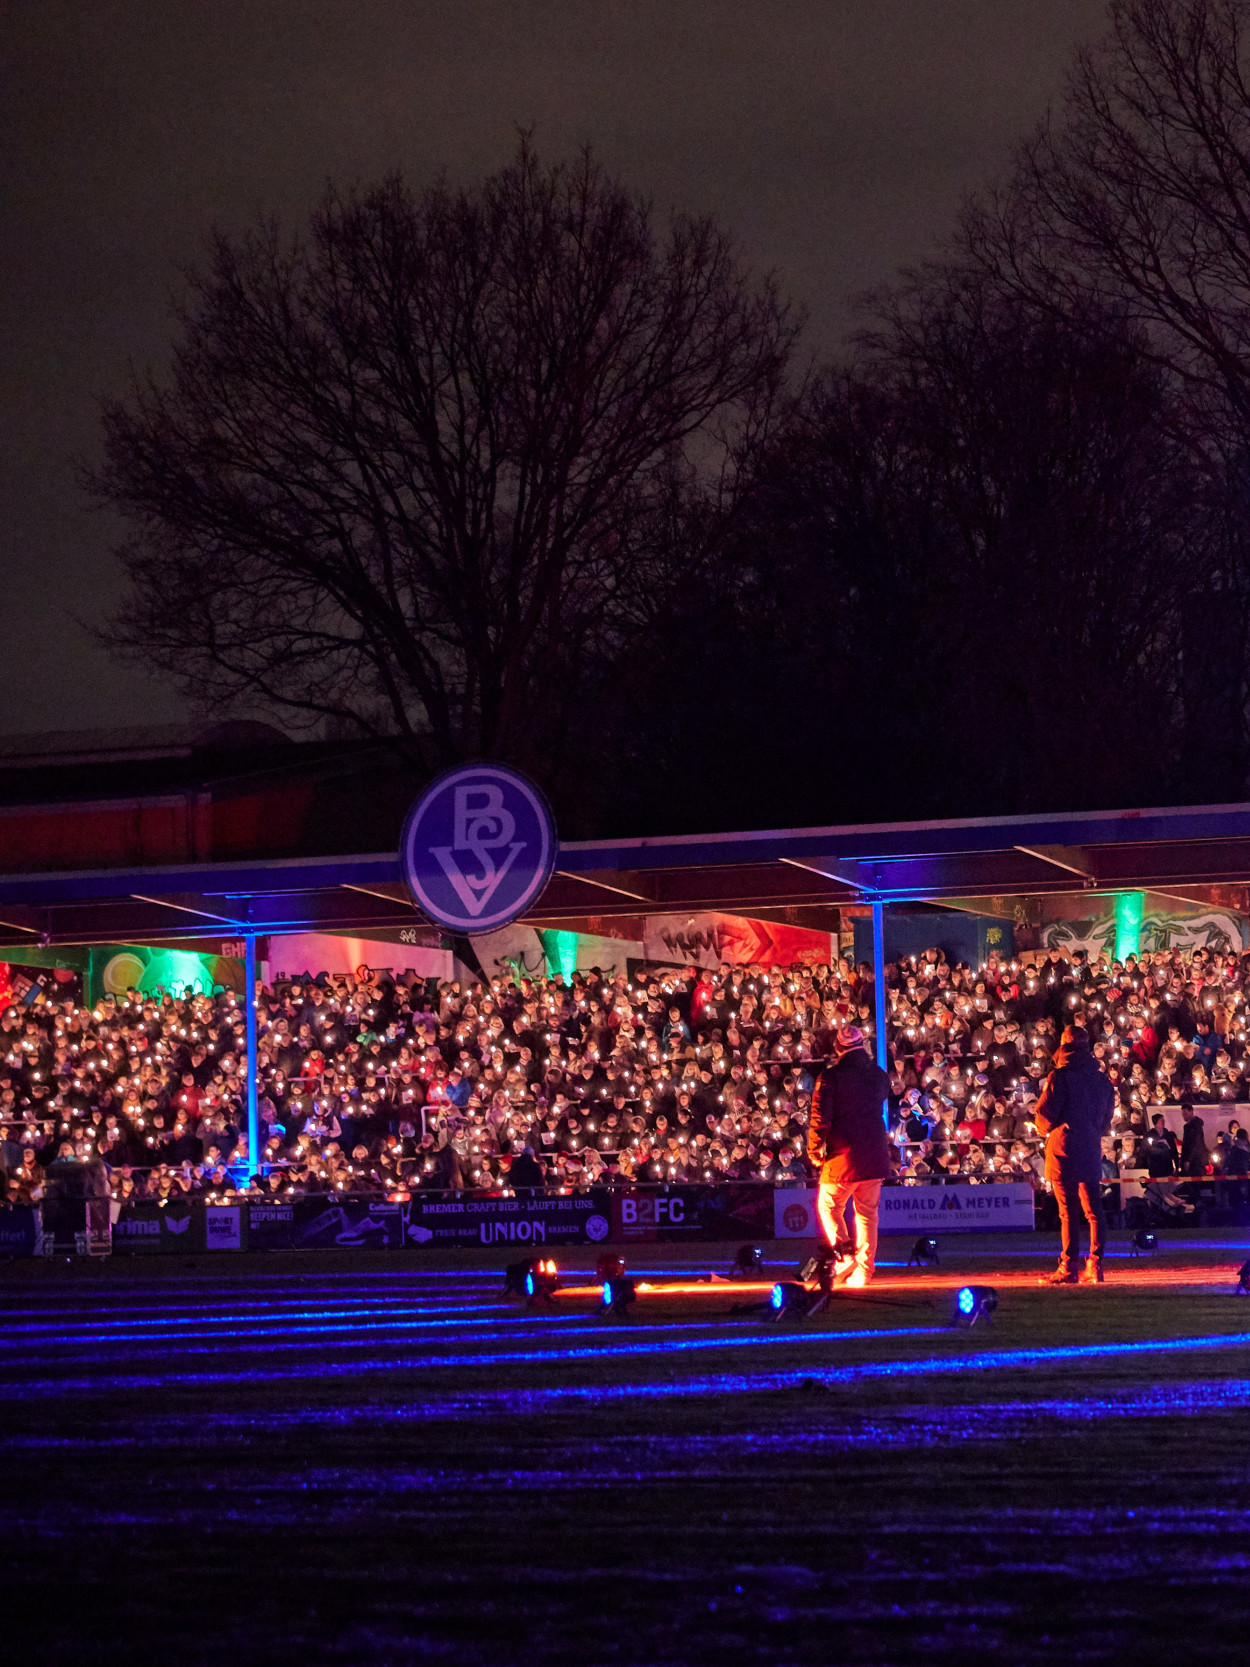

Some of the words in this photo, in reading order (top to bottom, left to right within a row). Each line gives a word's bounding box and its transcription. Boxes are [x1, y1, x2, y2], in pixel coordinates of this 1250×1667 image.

[422, 1203, 465, 1214] BREMER
[466, 1202, 497, 1213] CRAFT
[498, 1201, 519, 1212] BIER
[526, 1200, 558, 1211] LÄUFT
[558, 1200, 574, 1210] BEI
[621, 1197, 685, 1224] B2FC
[884, 1198, 936, 1211] RONALD
[966, 1196, 1010, 1209] MEYER
[479, 1220, 546, 1244] UNION
